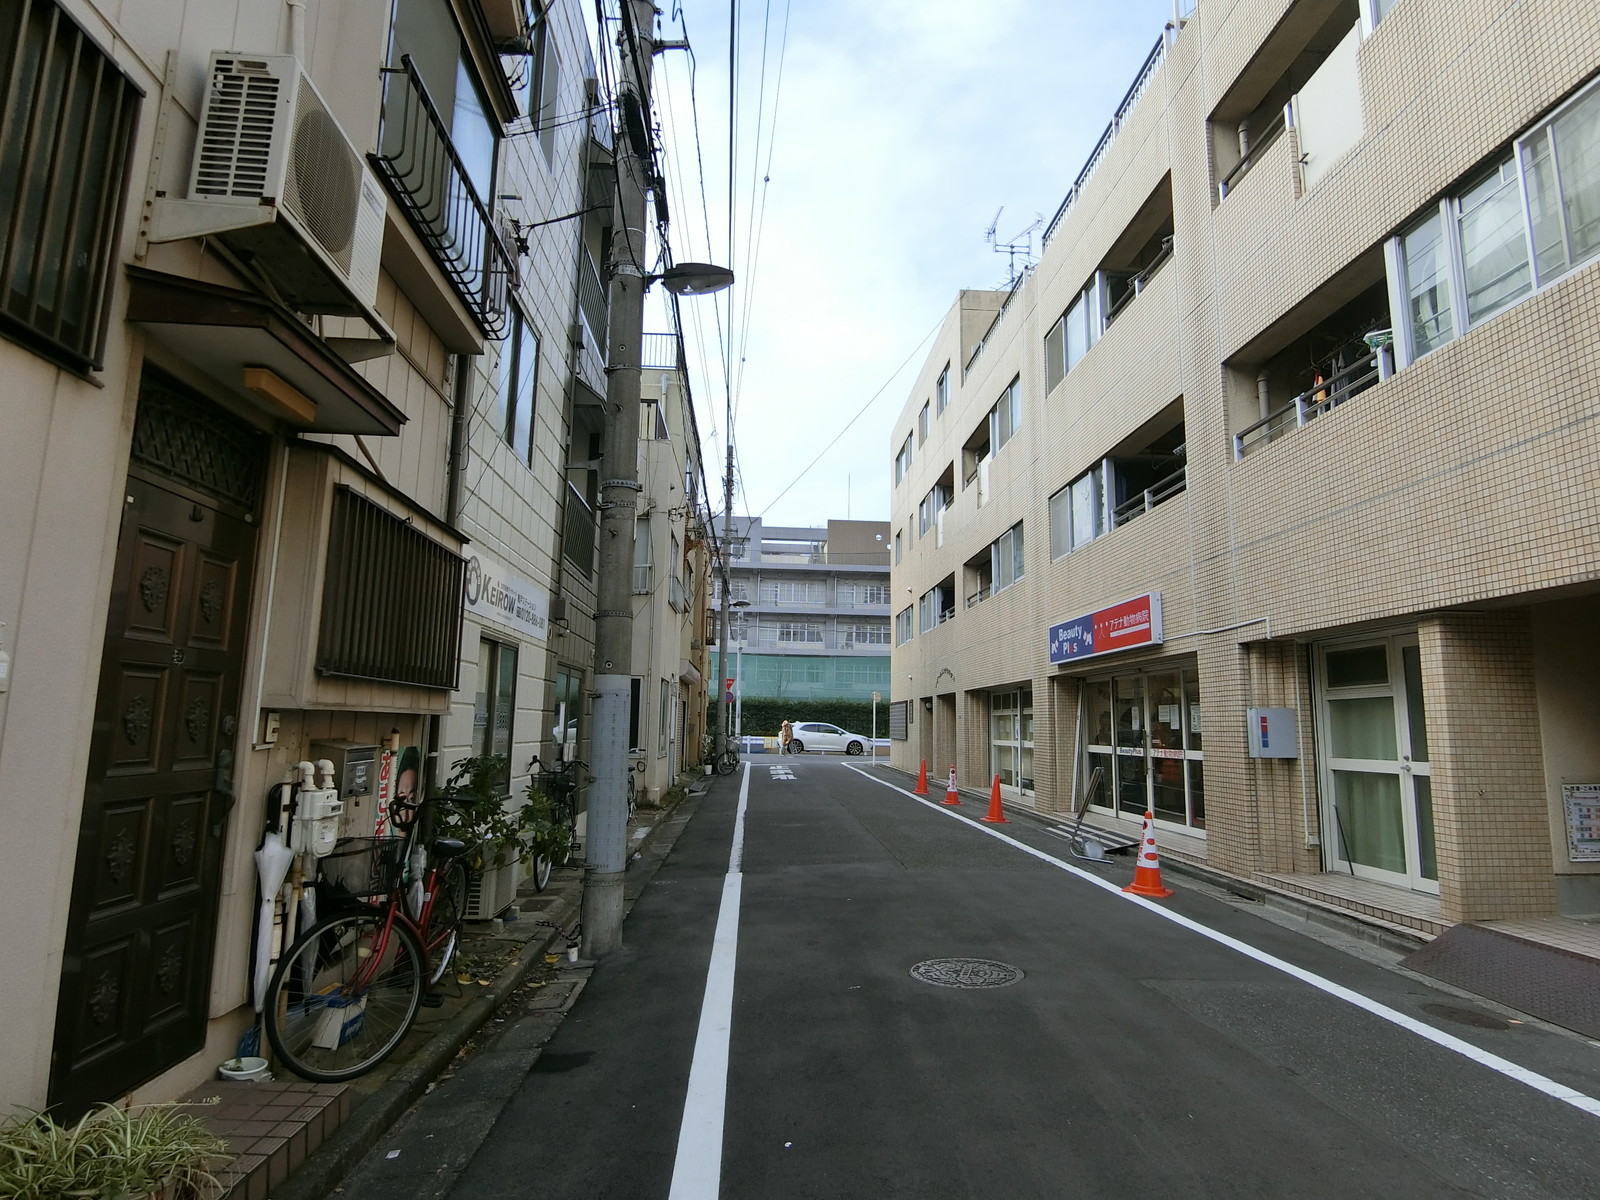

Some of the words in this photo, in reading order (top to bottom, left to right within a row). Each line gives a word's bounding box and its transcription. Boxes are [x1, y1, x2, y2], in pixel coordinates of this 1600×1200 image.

[1109, 609, 1149, 631] アテナ動物病院
[1058, 624, 1083, 642] Beauty
